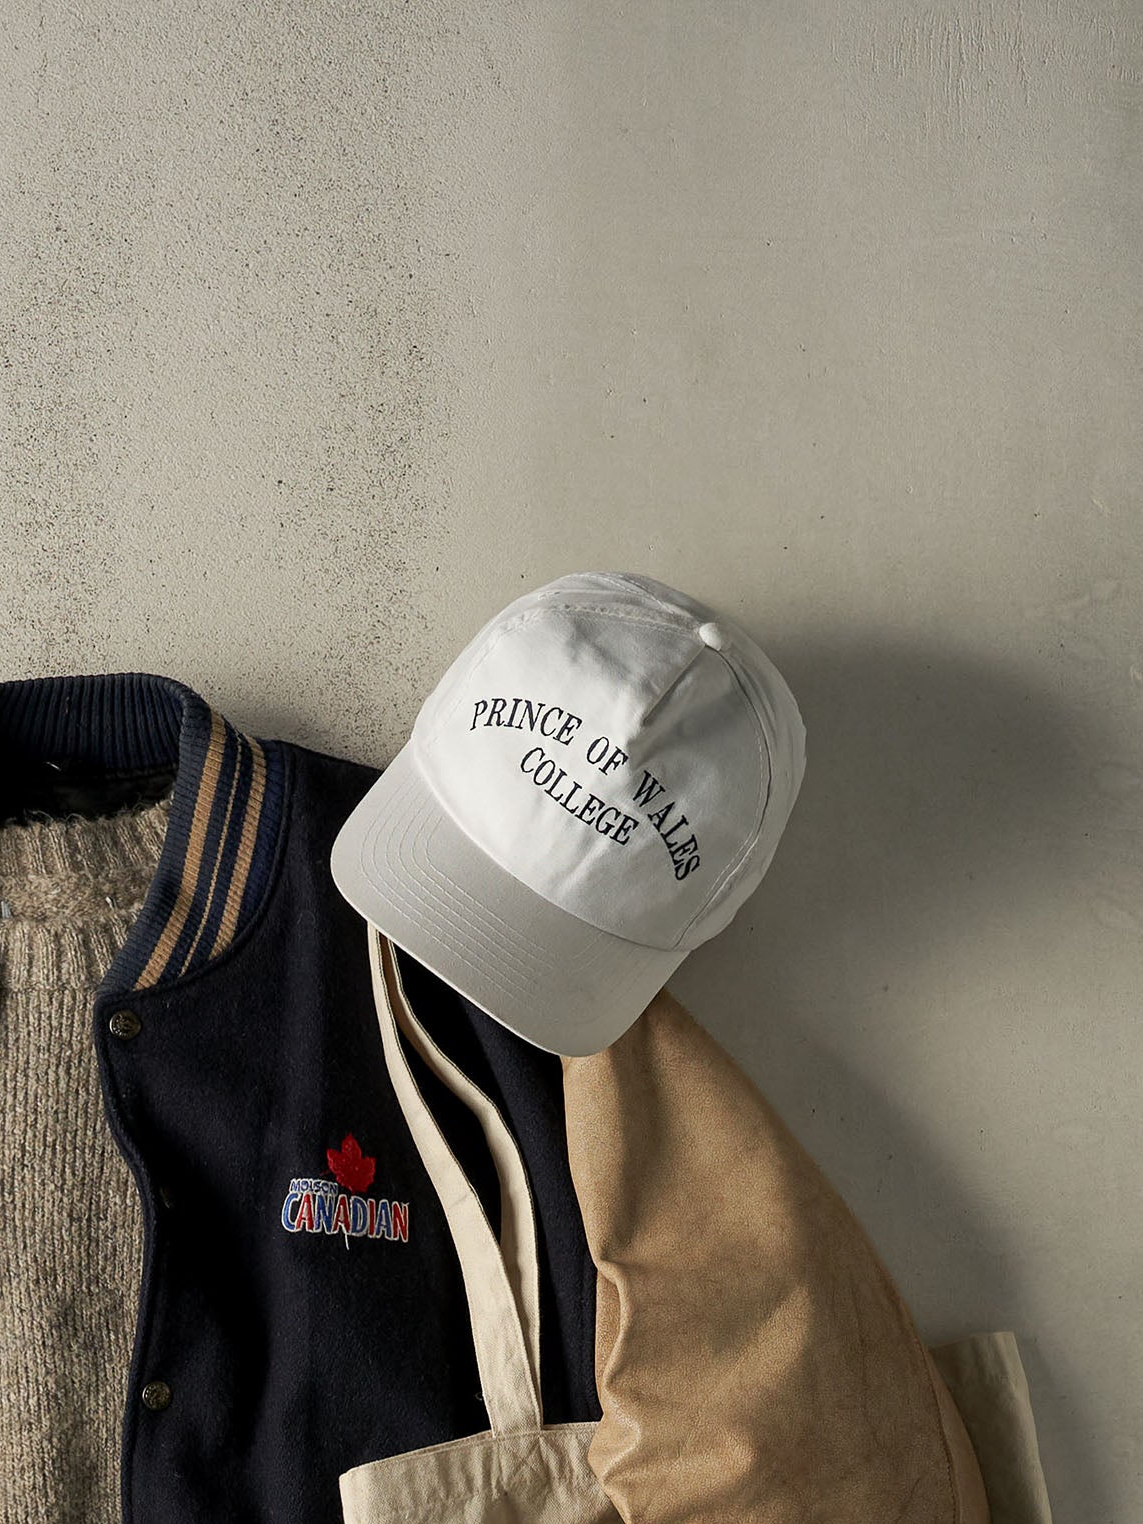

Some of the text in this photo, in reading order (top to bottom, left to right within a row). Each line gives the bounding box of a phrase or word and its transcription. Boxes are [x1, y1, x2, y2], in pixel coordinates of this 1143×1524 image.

[469, 697, 701, 881] PRINCE OF WALES
[519, 746, 639, 846] COLLEGE
[281, 1191, 410, 1243] CANADIAN
